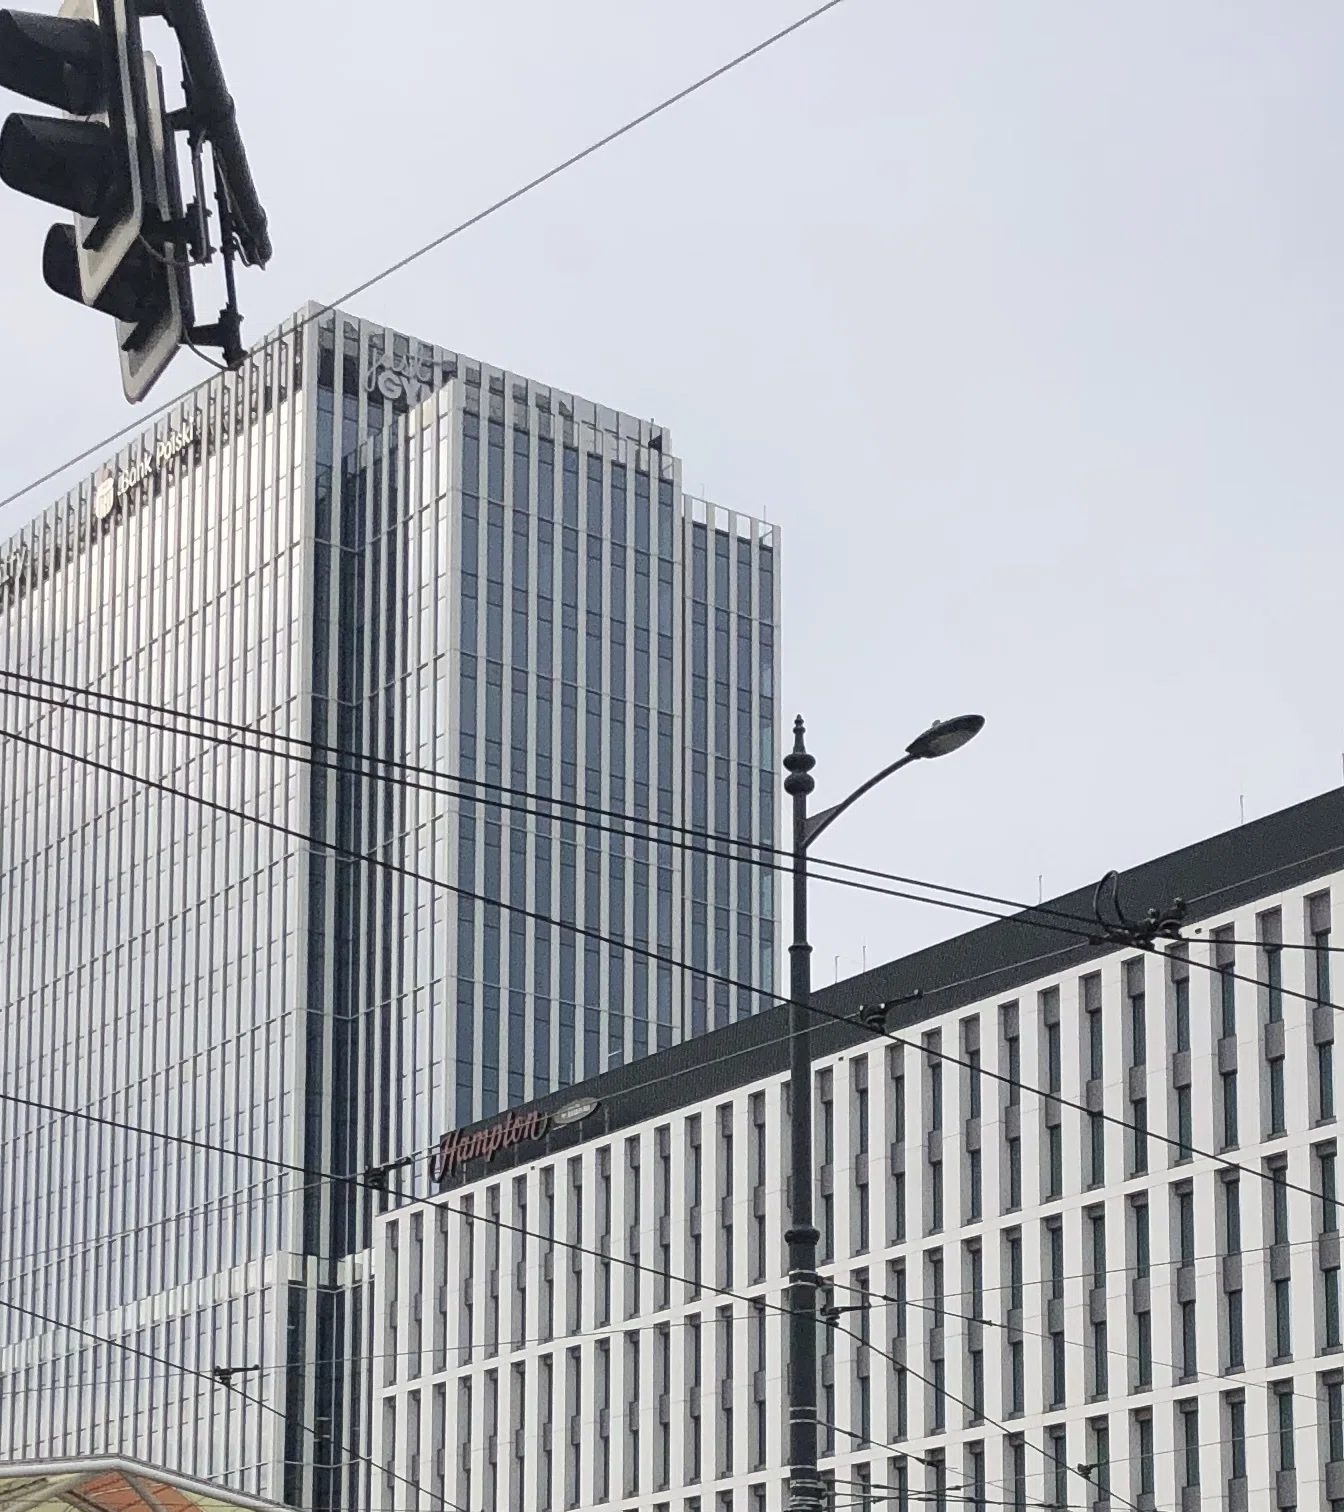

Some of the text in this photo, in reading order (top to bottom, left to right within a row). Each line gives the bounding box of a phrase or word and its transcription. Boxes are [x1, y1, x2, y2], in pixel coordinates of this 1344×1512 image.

[378, 371, 433, 406] GY
[156, 415, 194, 470] Polski
[430, 1110, 549, 1183] Hampton
